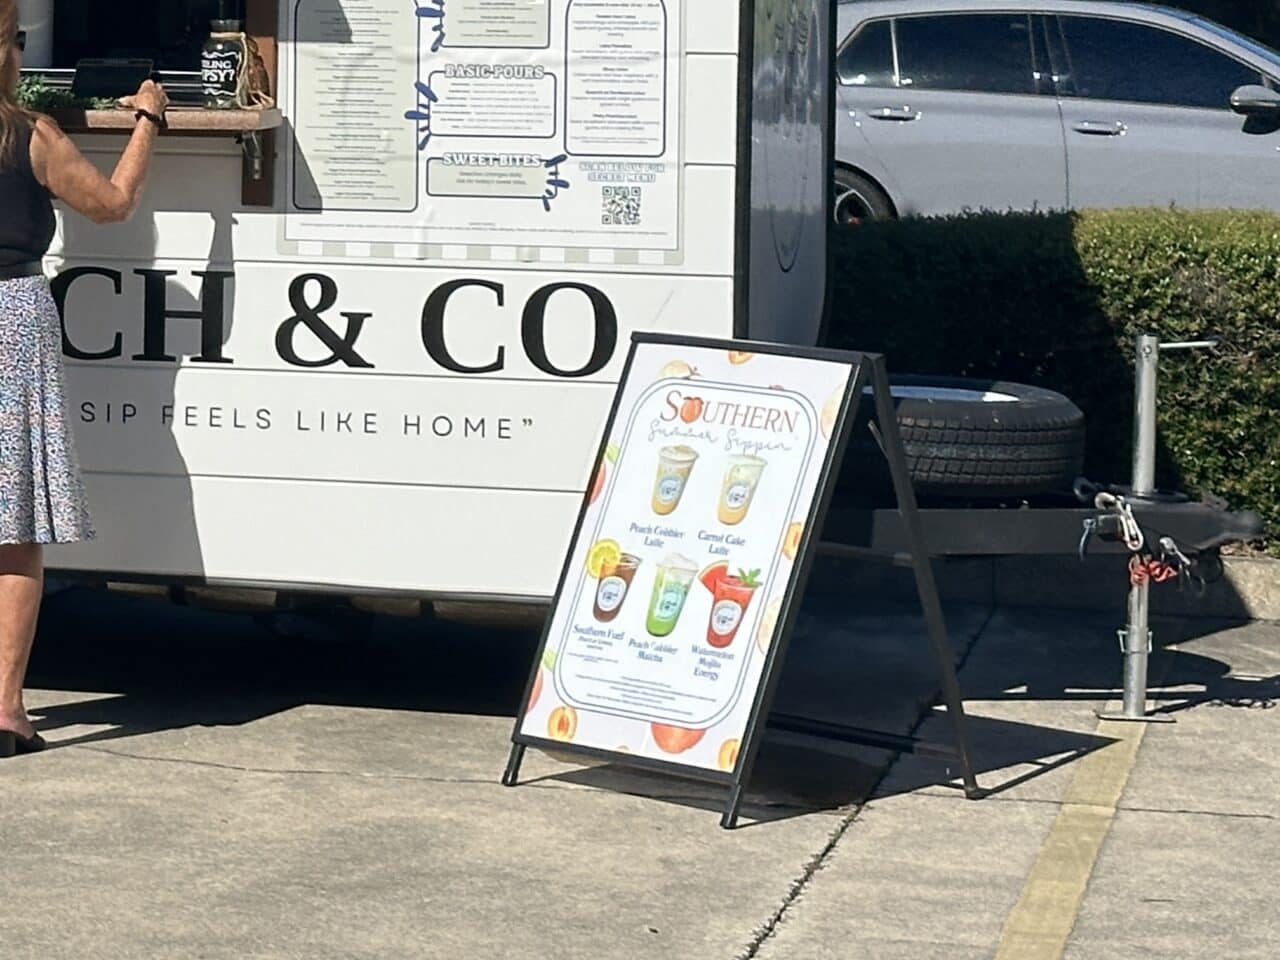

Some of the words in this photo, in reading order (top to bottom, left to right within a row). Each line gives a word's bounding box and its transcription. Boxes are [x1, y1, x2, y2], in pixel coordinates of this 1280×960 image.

[444, 64, 491, 78] BASIC
[493, 65, 545, 79] POURS
[442, 152, 497, 166] SWEET
[499, 153, 541, 167] BITES
[274, 272, 375, 368] &
[420, 278, 618, 378] CO
[80, 402, 137, 424] SIP
[162, 405, 271, 430] FEELS
[296, 410, 378, 435] LIKE
